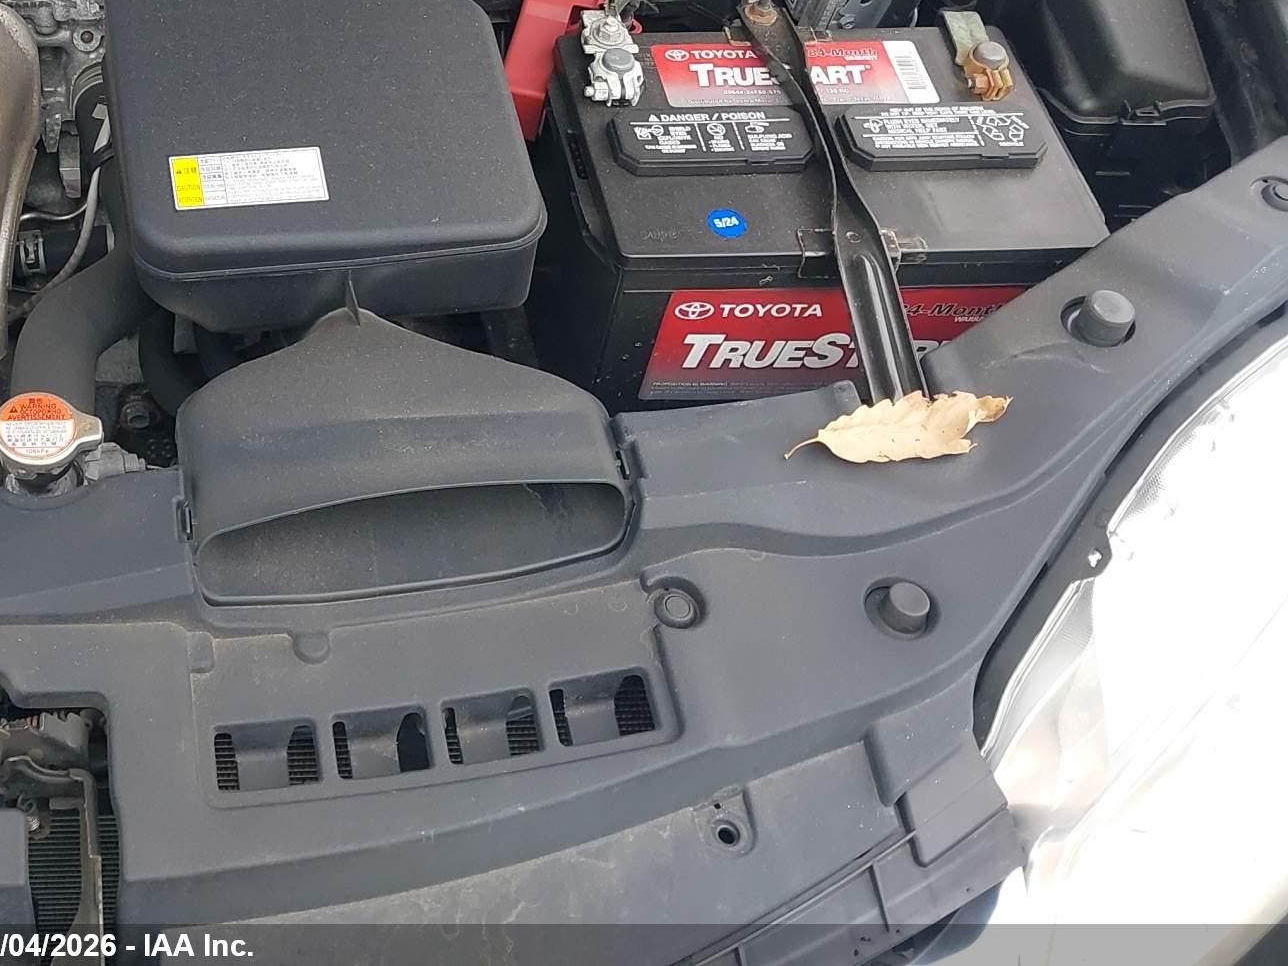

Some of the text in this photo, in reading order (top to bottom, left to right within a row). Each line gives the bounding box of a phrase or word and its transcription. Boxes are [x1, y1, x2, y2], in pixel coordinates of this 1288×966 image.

[690, 49, 758, 60] TOYOTA
[660, 114, 710, 122] DANGER
[721, 112, 766, 121] POISON
[713, 216, 740, 229] 5/24
[720, 303, 823, 319] TOYOTA
